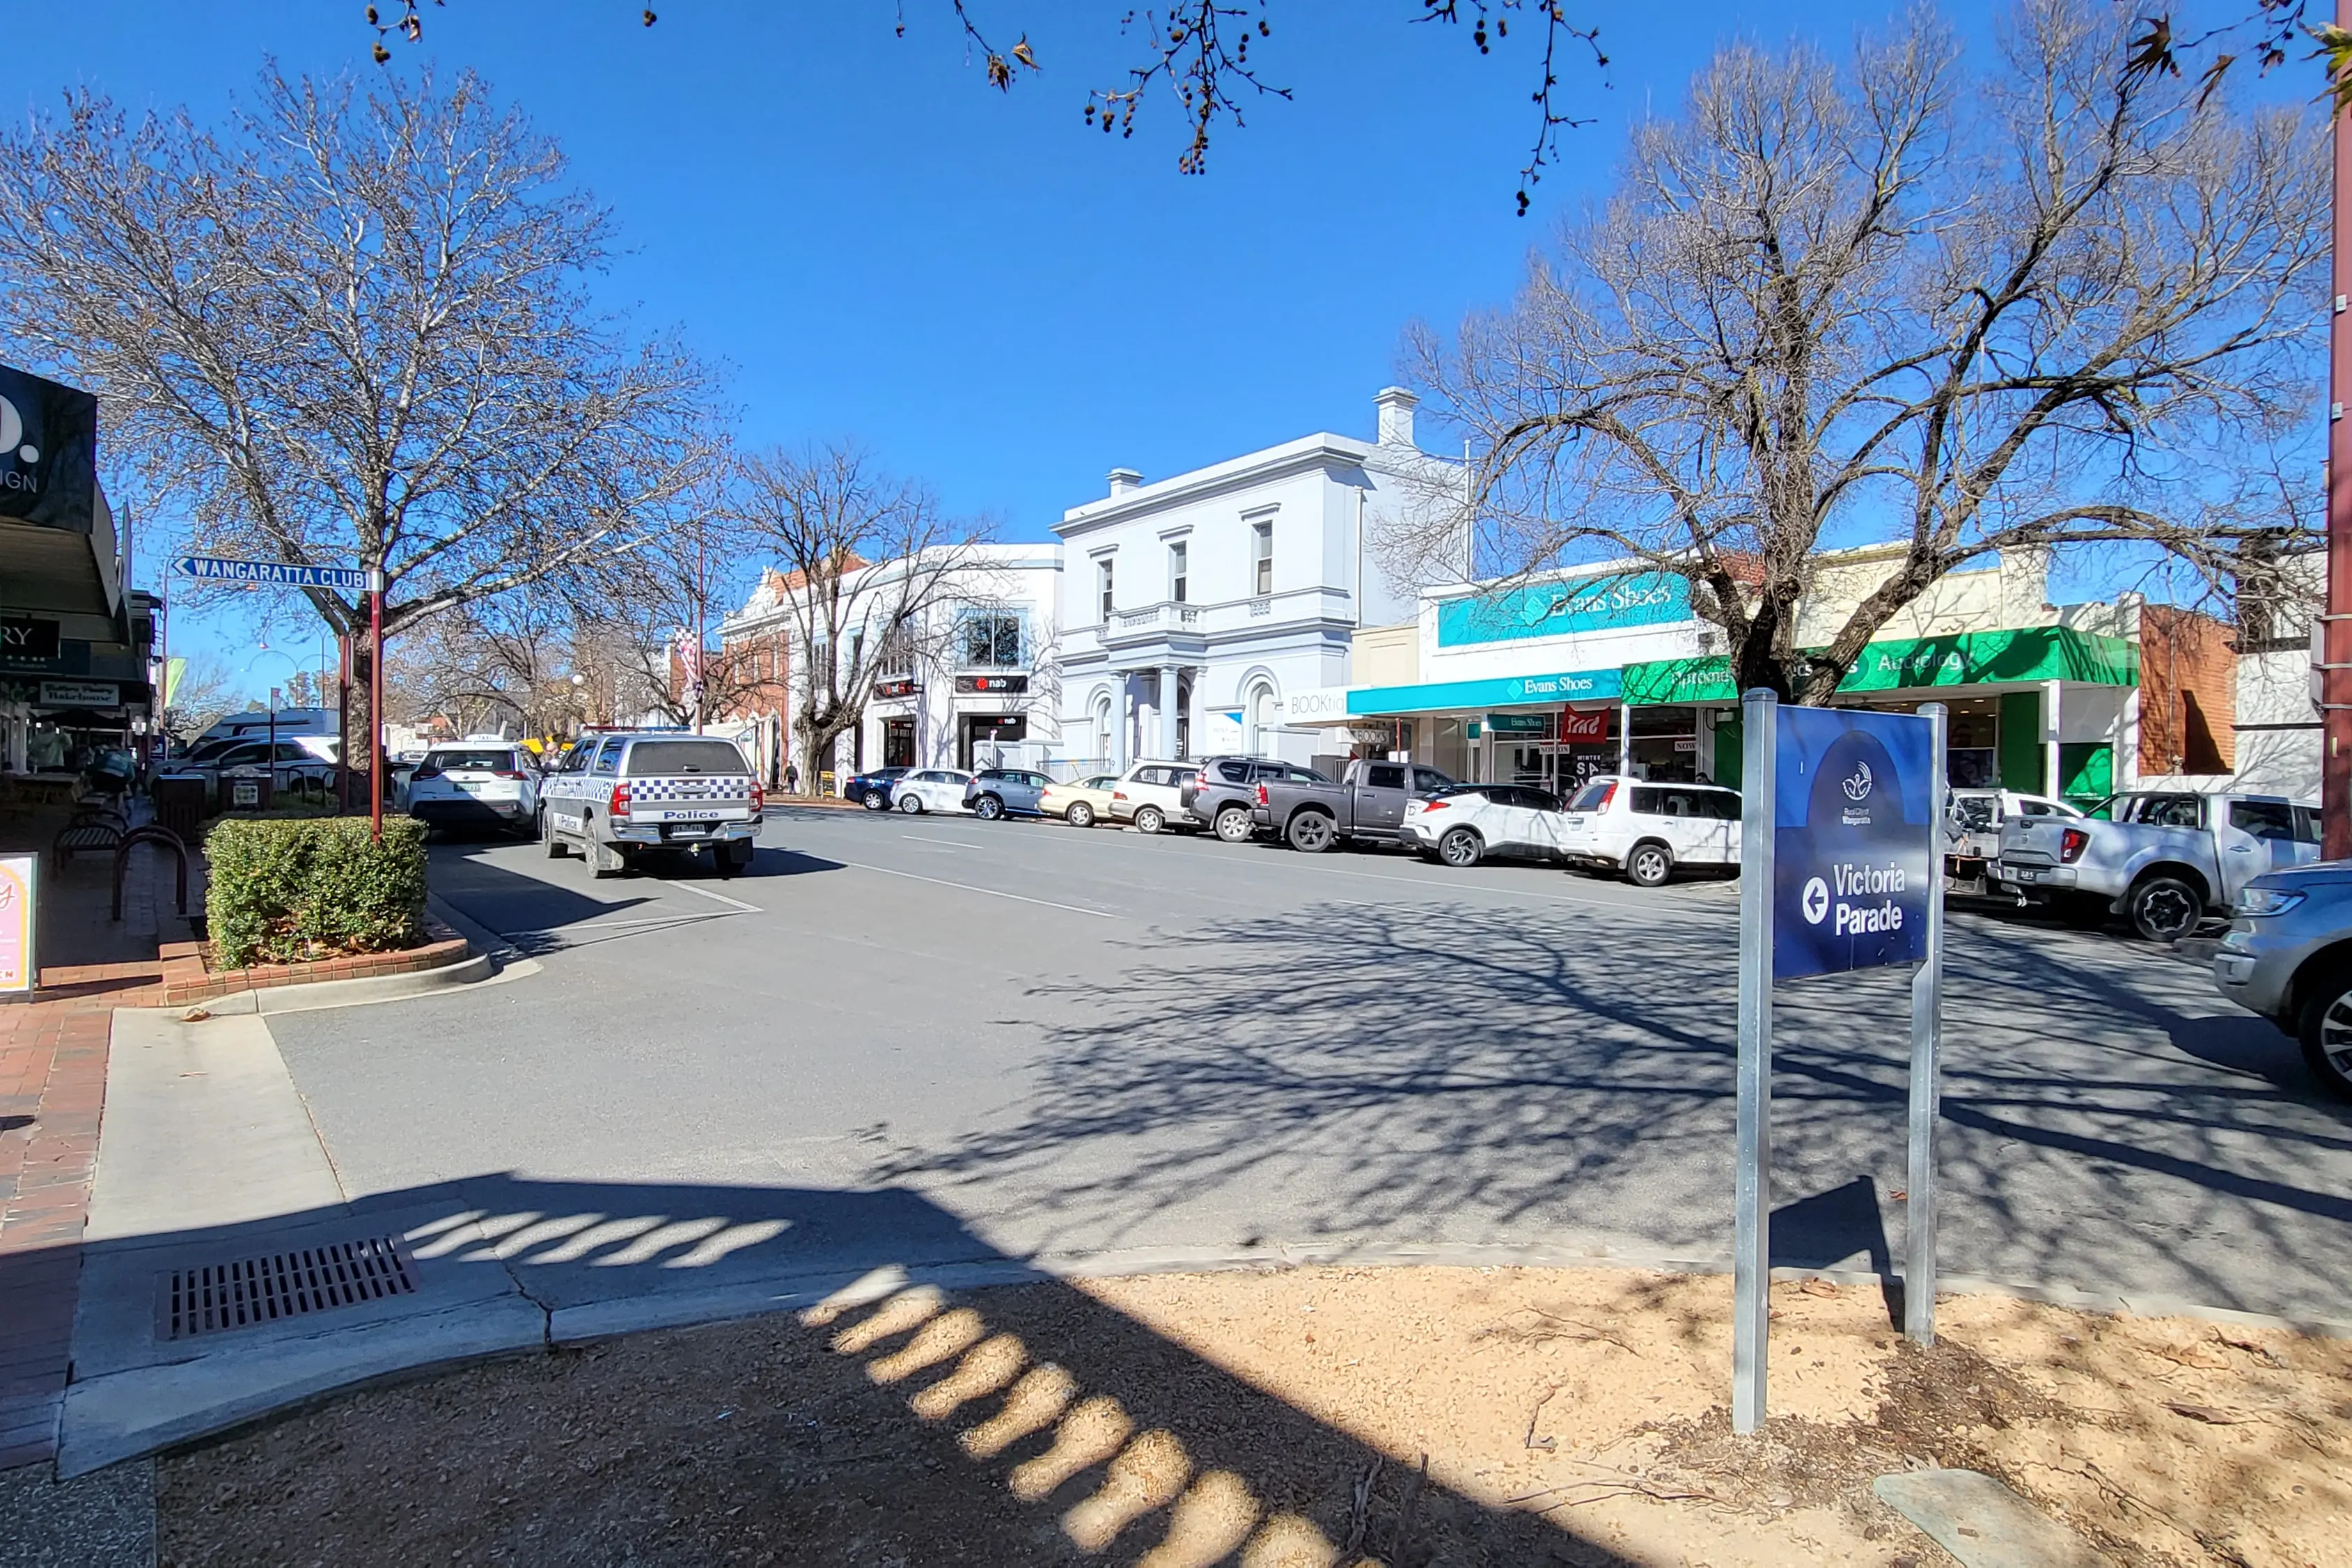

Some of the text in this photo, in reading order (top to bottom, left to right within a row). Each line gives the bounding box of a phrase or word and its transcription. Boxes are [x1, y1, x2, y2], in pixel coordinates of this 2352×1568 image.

[194, 558, 364, 587] WANGARATTA CLUB
[1878, 652, 1973, 671] Audiology
[989, 679, 1007, 689] nab
[1524, 677, 1593, 694] Evans Shoes
[1358, 730, 1387, 742] BOOKS
[560, 815, 577, 830] Police
[664, 811, 719, 820] Police
[1833, 861, 1905, 896] Victoria
[1835, 899, 1903, 936] Parade
